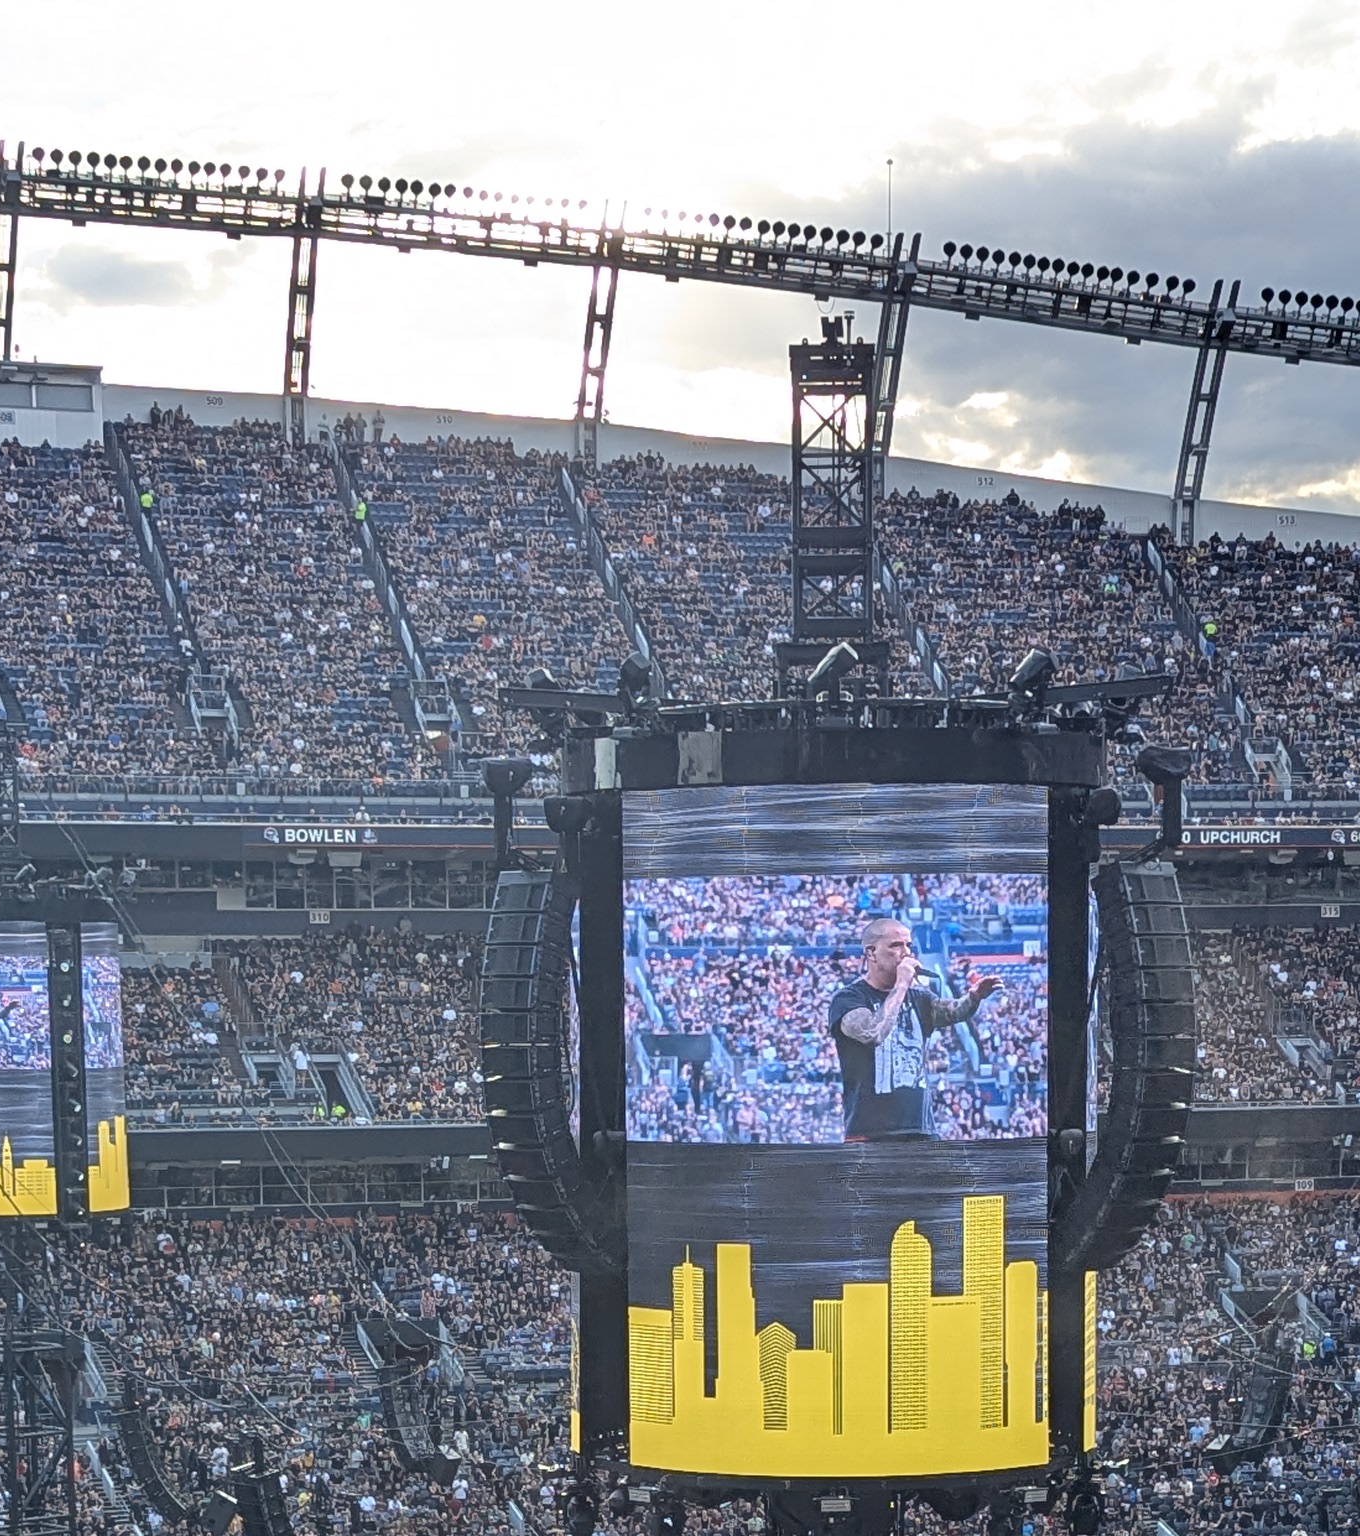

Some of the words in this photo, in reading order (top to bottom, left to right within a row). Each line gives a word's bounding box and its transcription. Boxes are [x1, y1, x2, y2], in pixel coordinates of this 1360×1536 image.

[436, 415, 453, 424] 510
[977, 477, 994, 486] 512
[1278, 515, 1295, 524] 513
[285, 828, 357, 843] BOWLEN
[1200, 830, 1281, 843] UPCHURCH
[1322, 906, 1338, 916] 315
[311, 912, 329, 922] 310
[1296, 1180, 1312, 1190] 109
